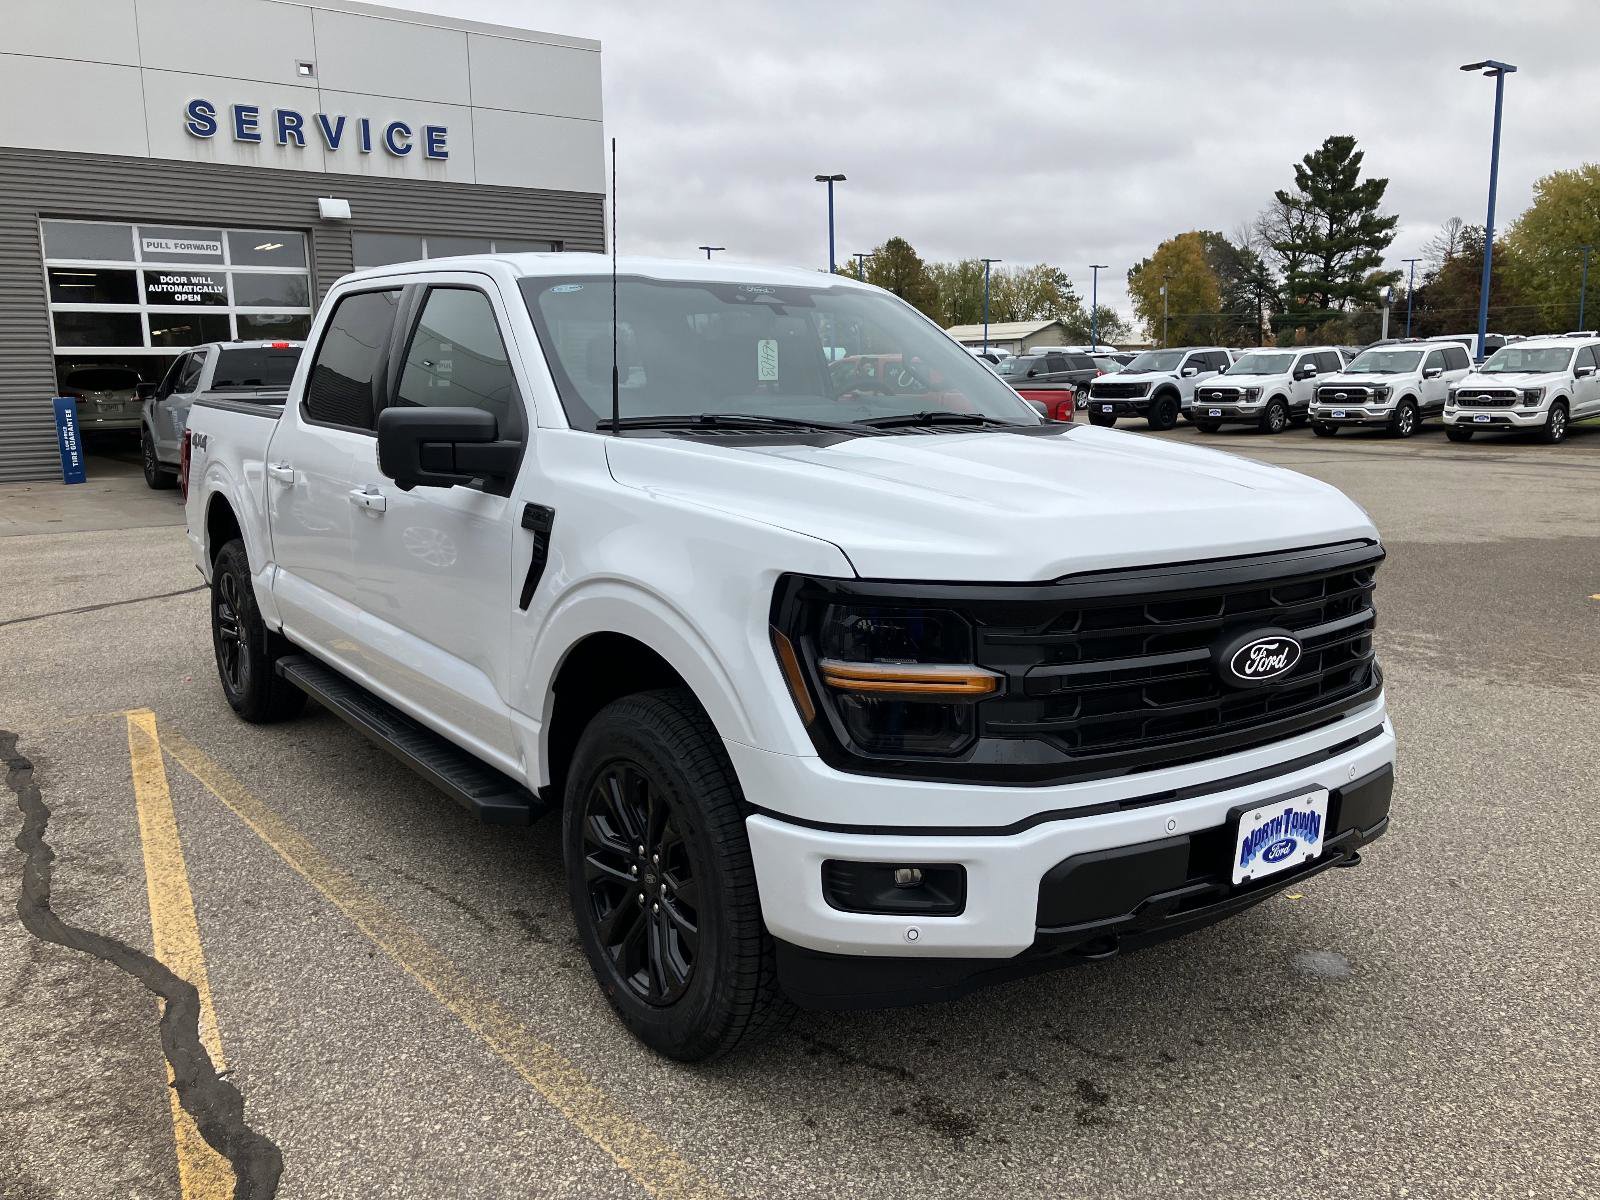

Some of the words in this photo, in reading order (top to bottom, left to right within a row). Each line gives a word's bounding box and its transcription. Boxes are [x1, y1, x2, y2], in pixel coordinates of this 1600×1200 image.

[185, 98, 449, 160] SERVICE
[146, 241, 171, 249] PULL
[174, 243, 219, 251] FORWARD
[148, 285, 224, 293] AUTOMATICALLY
[160, 276, 188, 284] DOOR
[191, 277, 214, 285] WILL
[174, 294, 201, 302] OPEN
[65, 408, 77, 451] GUARANTEE
[70, 451, 79, 468] TIRE
[1244, 642, 1289, 675] Ford
[1268, 840, 1291, 860] Ford
